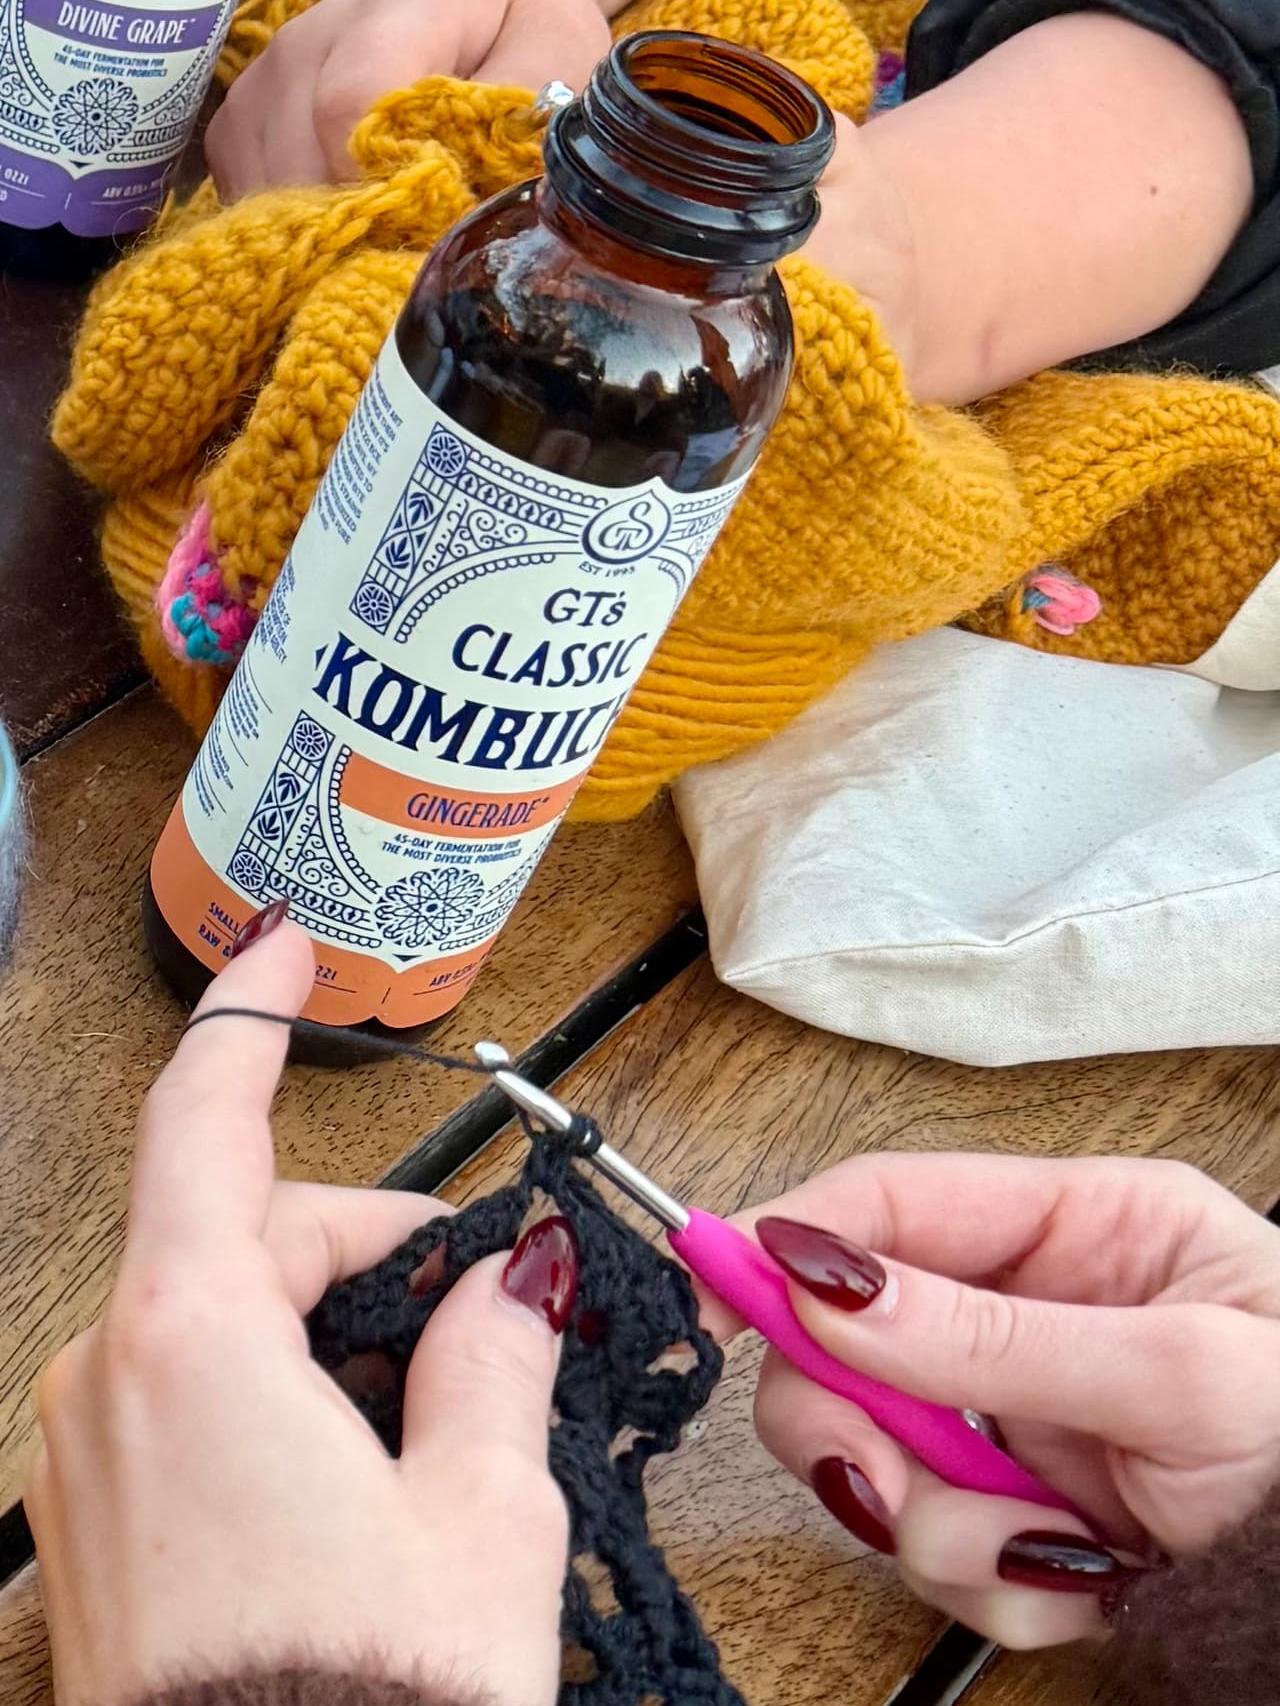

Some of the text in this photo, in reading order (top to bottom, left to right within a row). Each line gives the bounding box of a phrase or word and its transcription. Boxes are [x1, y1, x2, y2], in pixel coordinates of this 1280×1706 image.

[57, 1, 124, 40] DIVINE
[92, 53, 149, 67] FERMENTATION
[93, 61, 125, 76] DIVERSE
[4, 167, 30, 186] 0221
[578, 560, 603, 576] EST
[542, 587, 628, 628] GT's
[452, 623, 648, 688] CLASSIC
[312, 630, 628, 772] KOMBUC
[406, 793, 540, 829] GINGERADE
[382, 841, 402, 855] THE
[403, 848, 433, 862] MOST
[434, 853, 472, 865] DIVERSE
[394, 833, 433, 849] 45-DAY
[434, 841, 505, 854] FERMENTATION
[207, 901, 240, 935] SMALL
[197, 923, 232, 958] RAW &
